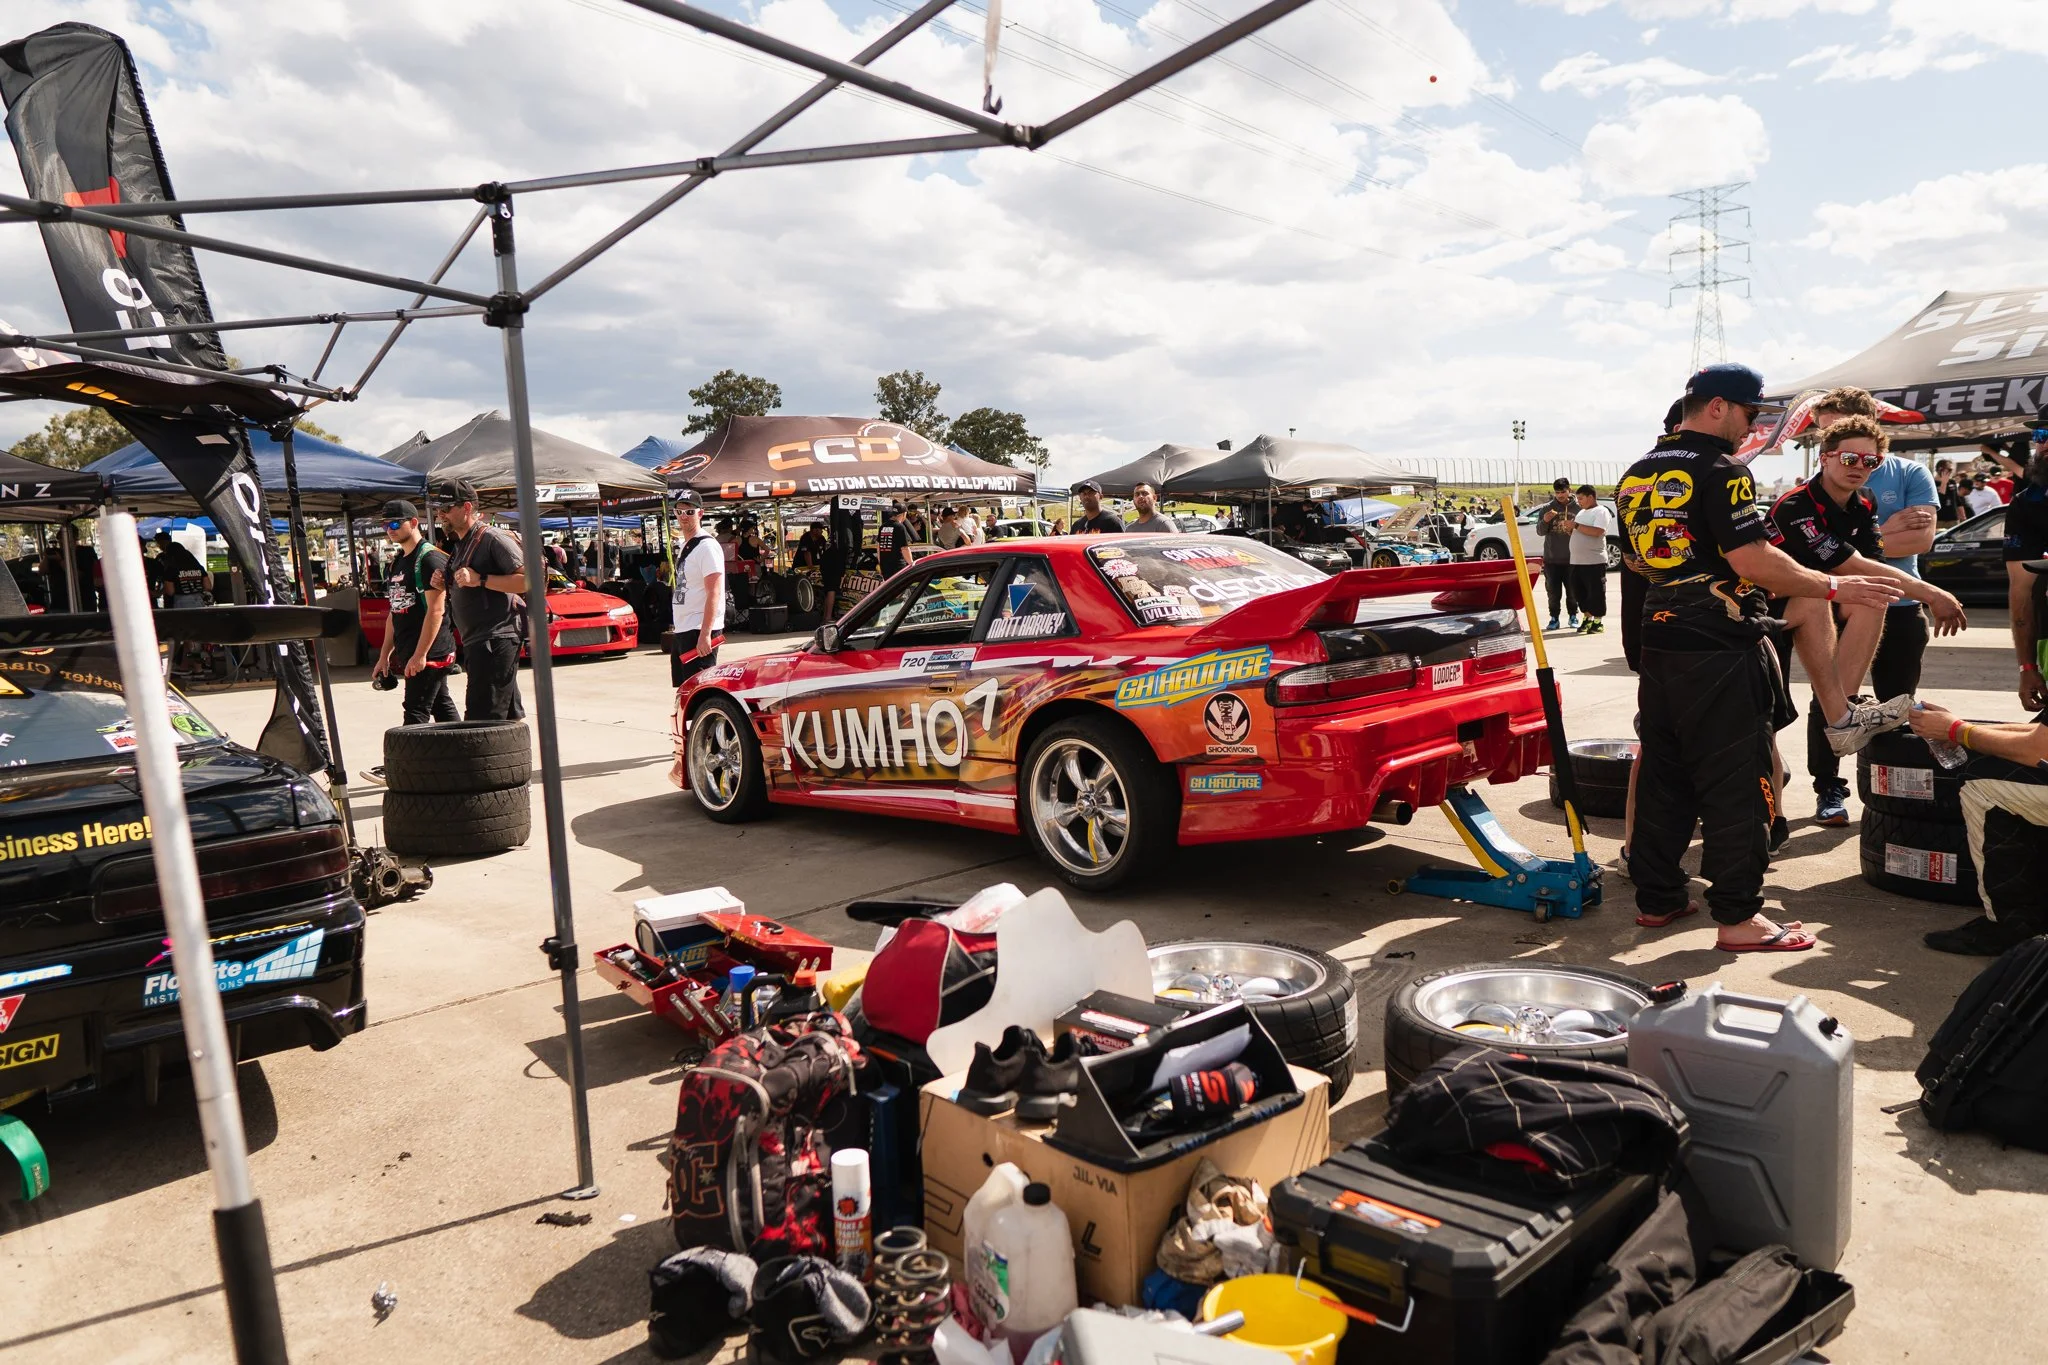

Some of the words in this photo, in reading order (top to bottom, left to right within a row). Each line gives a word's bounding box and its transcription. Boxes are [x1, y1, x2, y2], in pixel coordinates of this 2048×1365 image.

[767, 436, 901, 471] CCD
[1687, 451, 1700, 459] BY
[720, 479, 797, 499] CCD
[807, 475, 868, 492] CUSTOM
[871, 474, 930, 490] CLUSTER
[931, 475, 1018, 492] DEVELOPMENT
[1726, 476, 1754, 506] 78
[841, 497, 858, 506] 96
[1003, 499, 1015, 507] 24
[1144, 605, 1202, 620] VILLAINS
[987, 615, 1022, 639] MATT
[1018, 612, 1066, 637] HARVEY
[903, 657, 926, 668] 720
[1117, 675, 1157, 700] GH
[1156, 653, 1271, 695] HAULAGE
[781, 699, 969, 771] KUMHO
[1207, 746, 1255, 754] SHOCKWORKS
[1190, 778, 1207, 789] GH
[1208, 777, 1262, 789] HAULAGE
[83, 816, 154, 848] Here!
